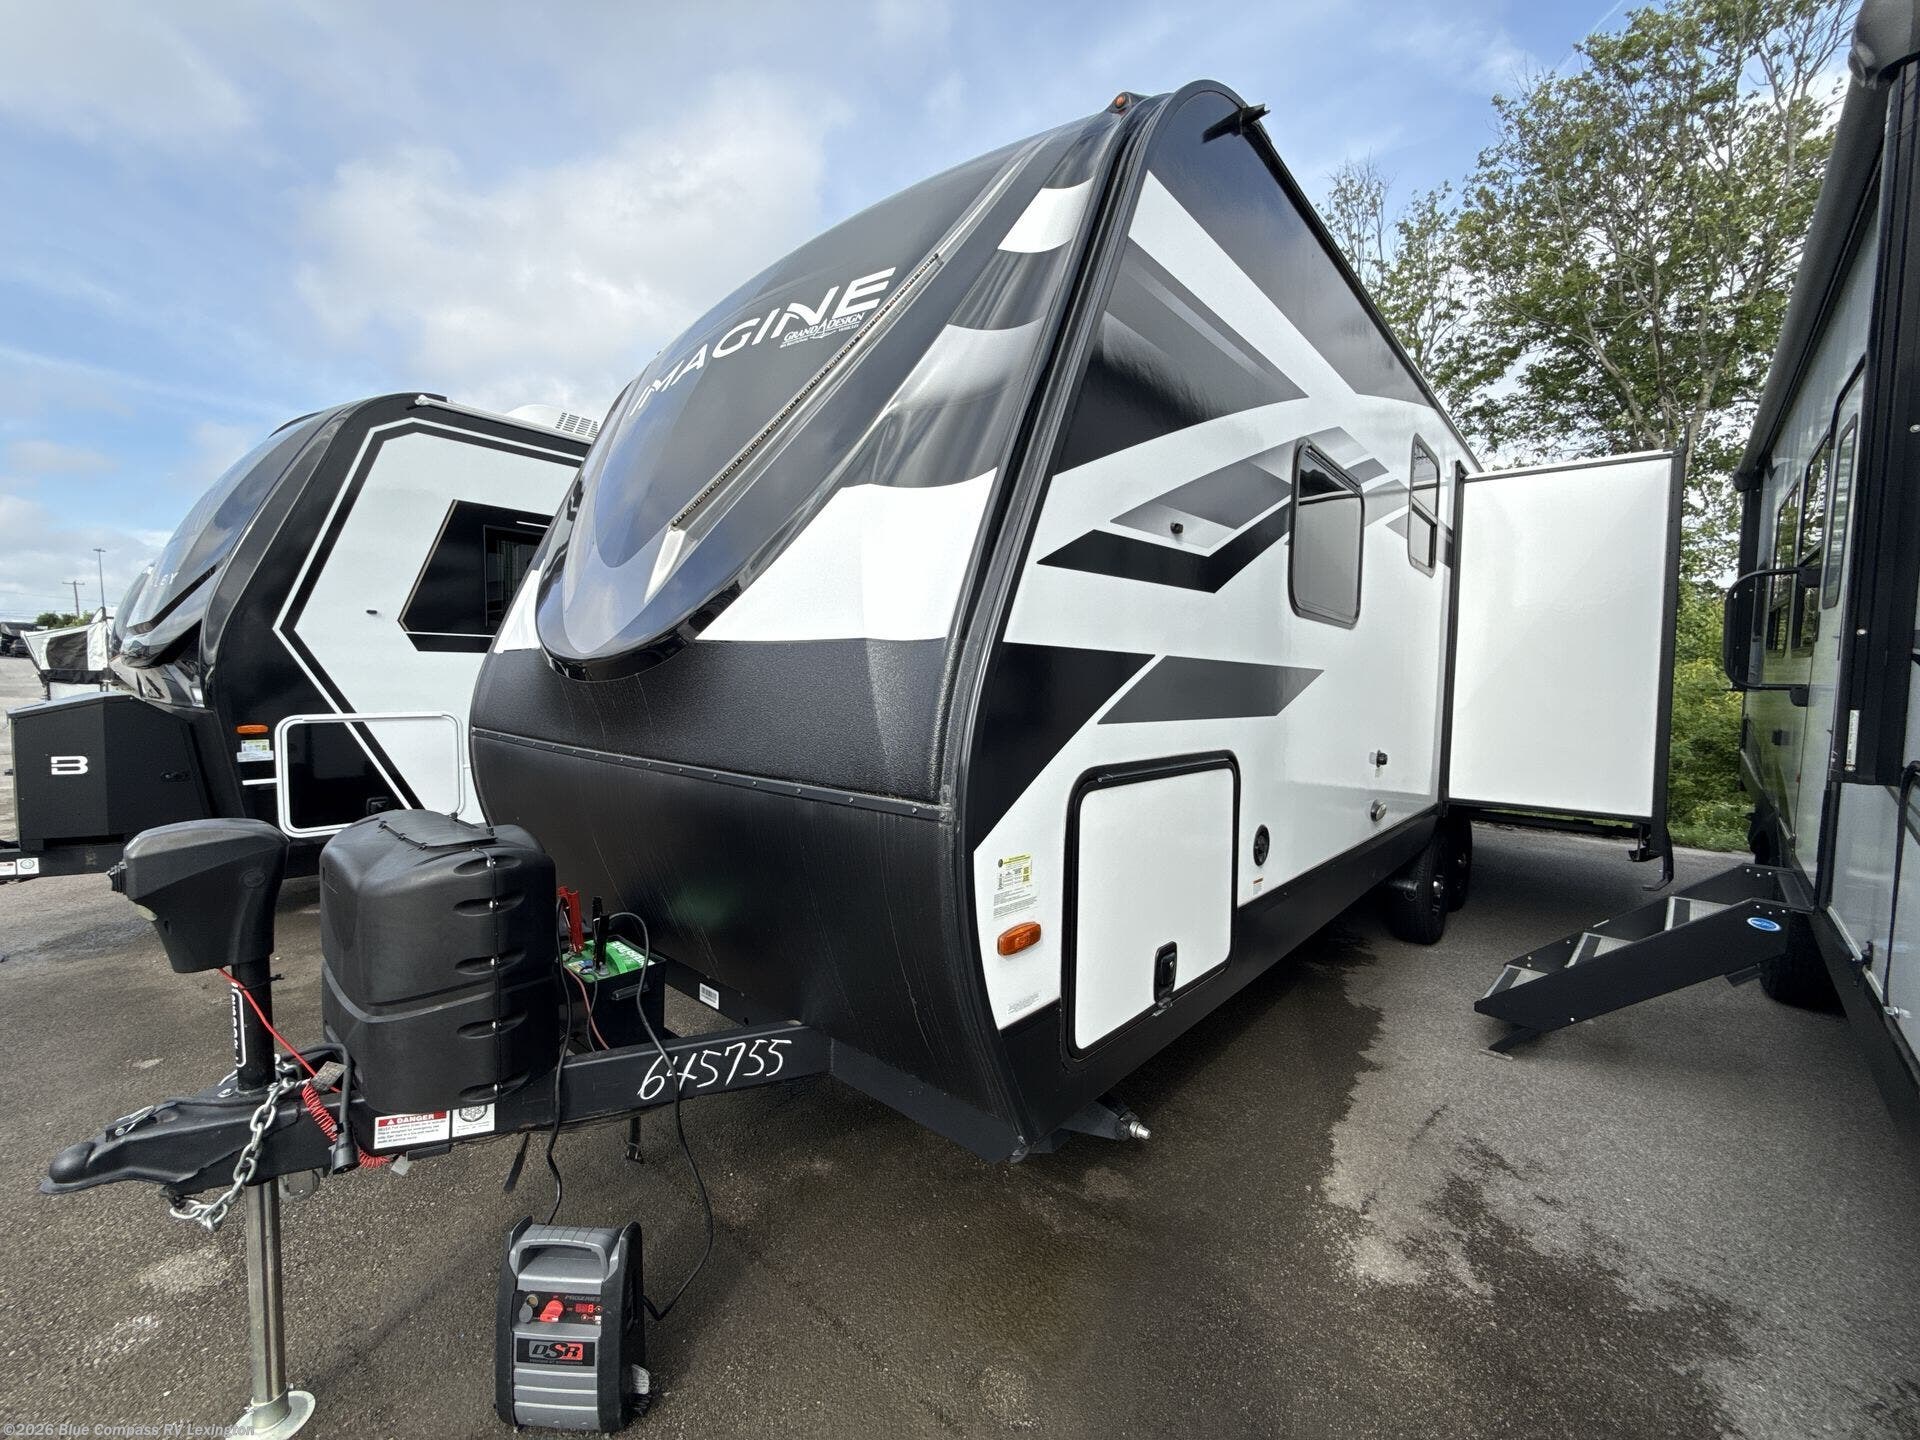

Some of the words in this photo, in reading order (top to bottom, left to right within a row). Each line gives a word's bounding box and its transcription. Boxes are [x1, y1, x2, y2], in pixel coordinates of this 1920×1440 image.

[784, 325, 818, 341] GRAND
[827, 312, 865, 329] DESIGN
[630, 267, 896, 416] IMAGINE
[51, 756, 88, 775] B
[637, 1039, 792, 1100] 645755
[397, 1112, 434, 1123] DANGER
[531, 1342, 581, 1358] DSR
